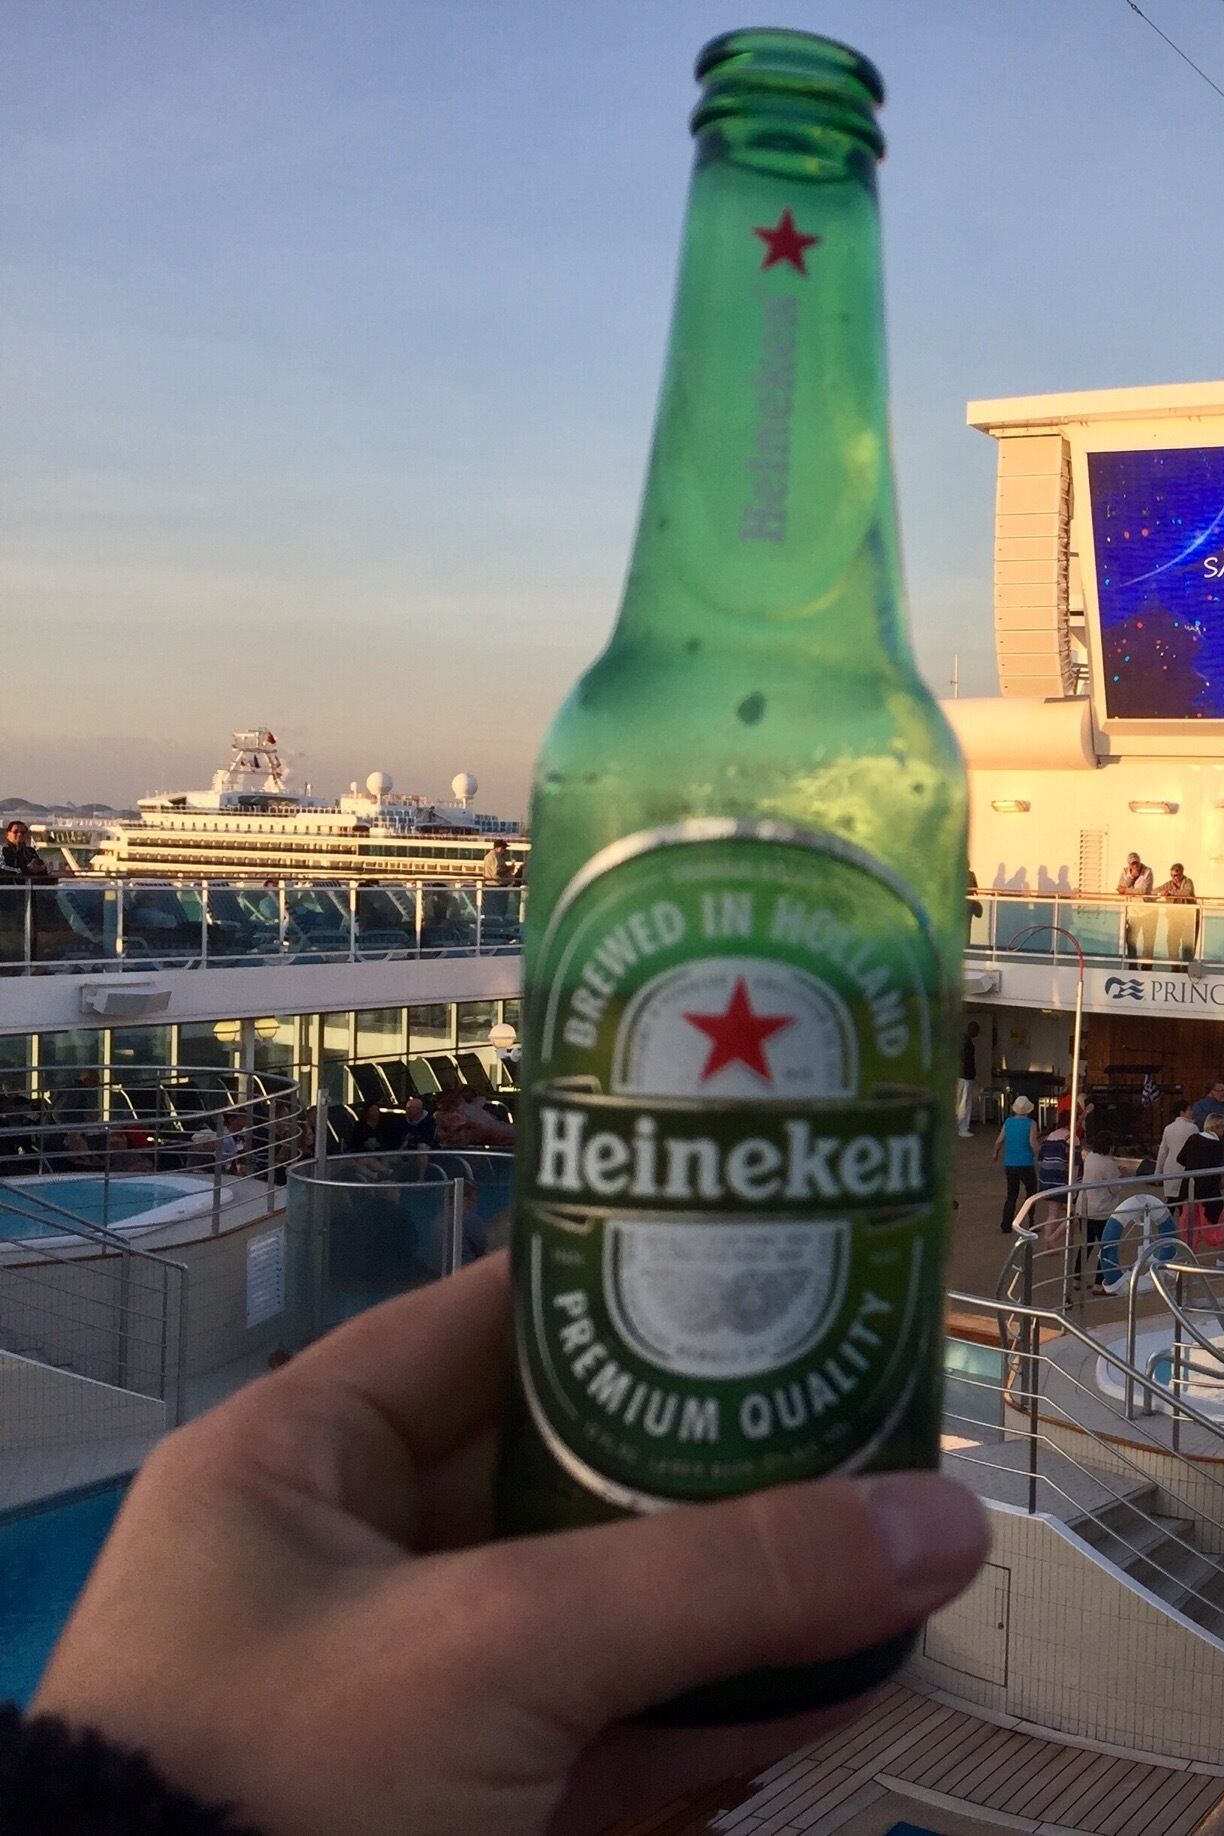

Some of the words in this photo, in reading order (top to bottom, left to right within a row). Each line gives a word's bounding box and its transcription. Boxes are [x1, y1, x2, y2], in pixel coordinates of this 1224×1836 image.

[563, 902, 687, 1049] BREWED
[702, 893, 753, 937] IN
[770, 900, 909, 1059] HOLLAND
[536, 1107, 926, 1199] Heineken
[553, 1289, 719, 1443] PREMIUM
[739, 1290, 895, 1439] QUALITY
